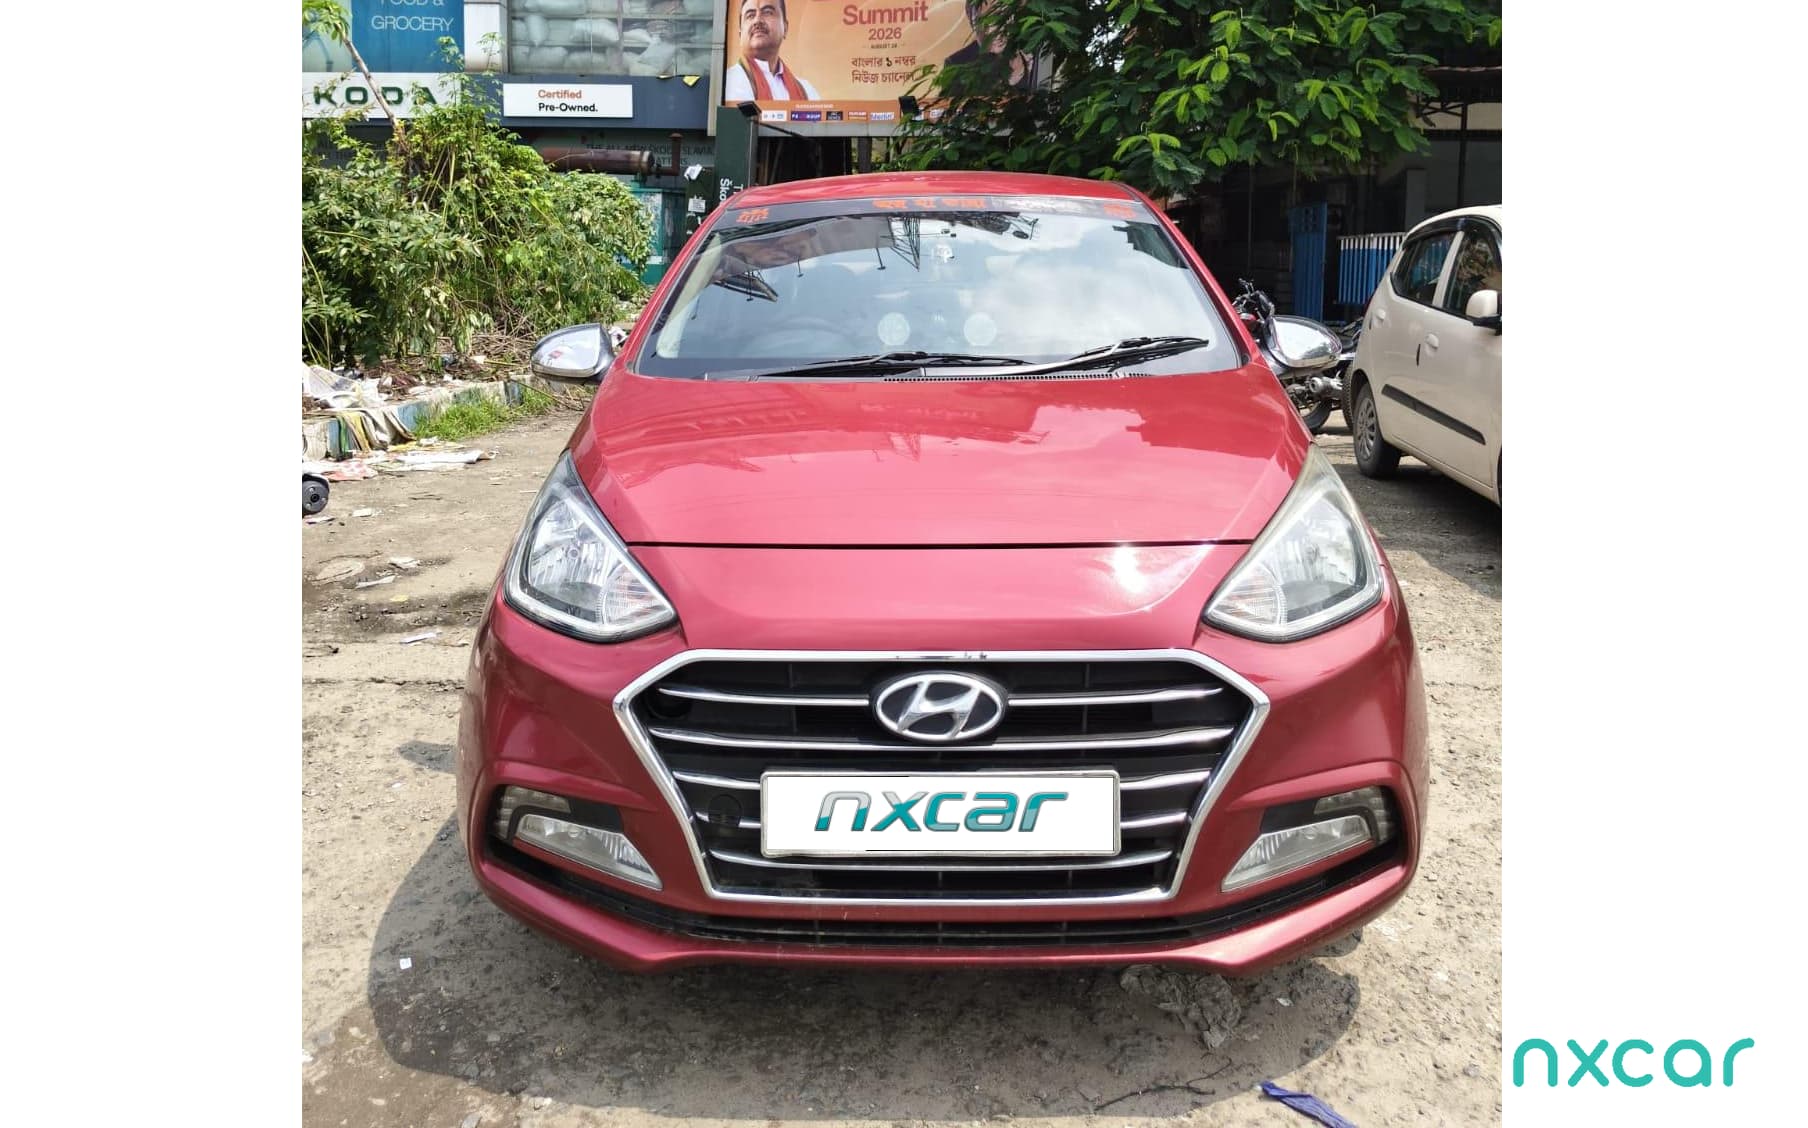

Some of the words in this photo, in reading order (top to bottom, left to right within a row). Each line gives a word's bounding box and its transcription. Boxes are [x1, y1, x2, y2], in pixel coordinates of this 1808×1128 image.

[843, 1, 929, 26] Summit
[371, 15, 455, 32] GROCERY
[868, 27, 902, 41] 2026
[538, 89, 582, 99] Certified
[538, 103, 598, 112] Pre-Owned.
[719, 178, 733, 203] Ško
